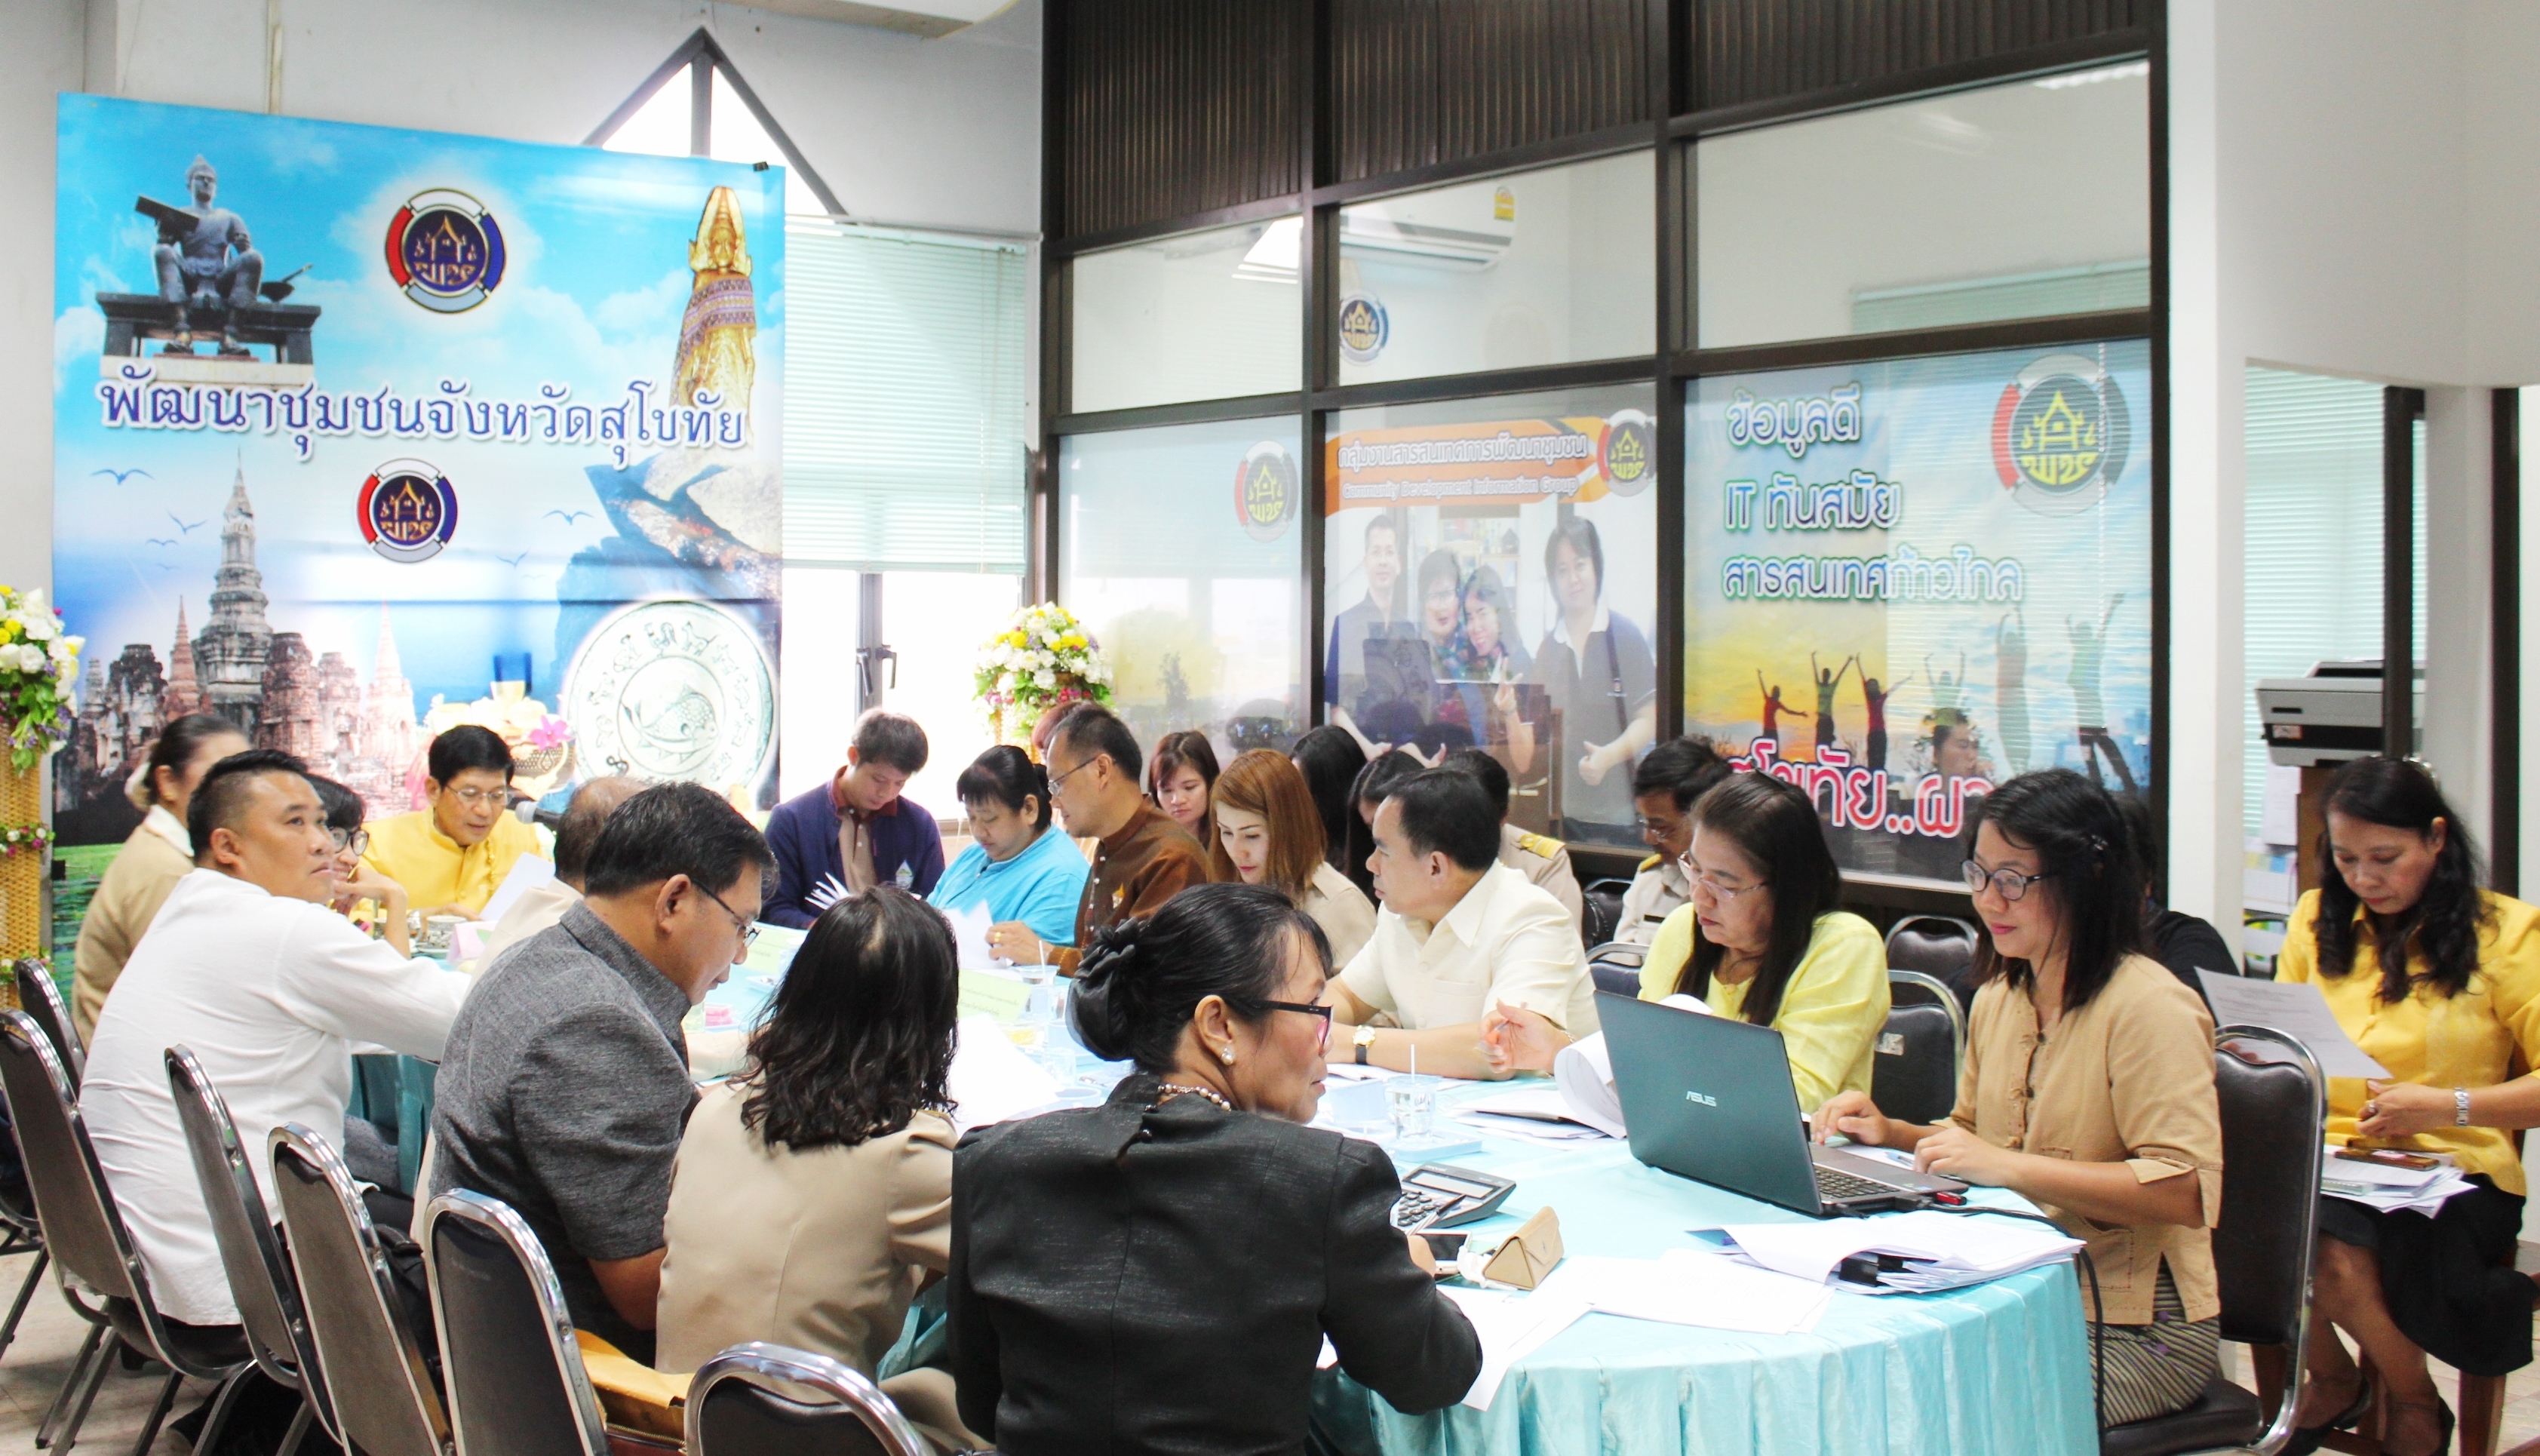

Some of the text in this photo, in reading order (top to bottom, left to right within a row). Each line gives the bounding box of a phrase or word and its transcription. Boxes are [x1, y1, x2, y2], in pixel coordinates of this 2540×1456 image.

[98, 364, 747, 465] พัฒนาชุมชนจังหวัดสุโขทัย
[1728, 385, 1860, 456] ข้อมูลดี
[1343, 475, 1579, 501] Community Development Information Group
[1728, 472, 1901, 528] IT ทันสมัย
[1724, 545, 2022, 600] สารสนเทศก้าวไกล
[1686, 1091, 1717, 1107] ASUS
